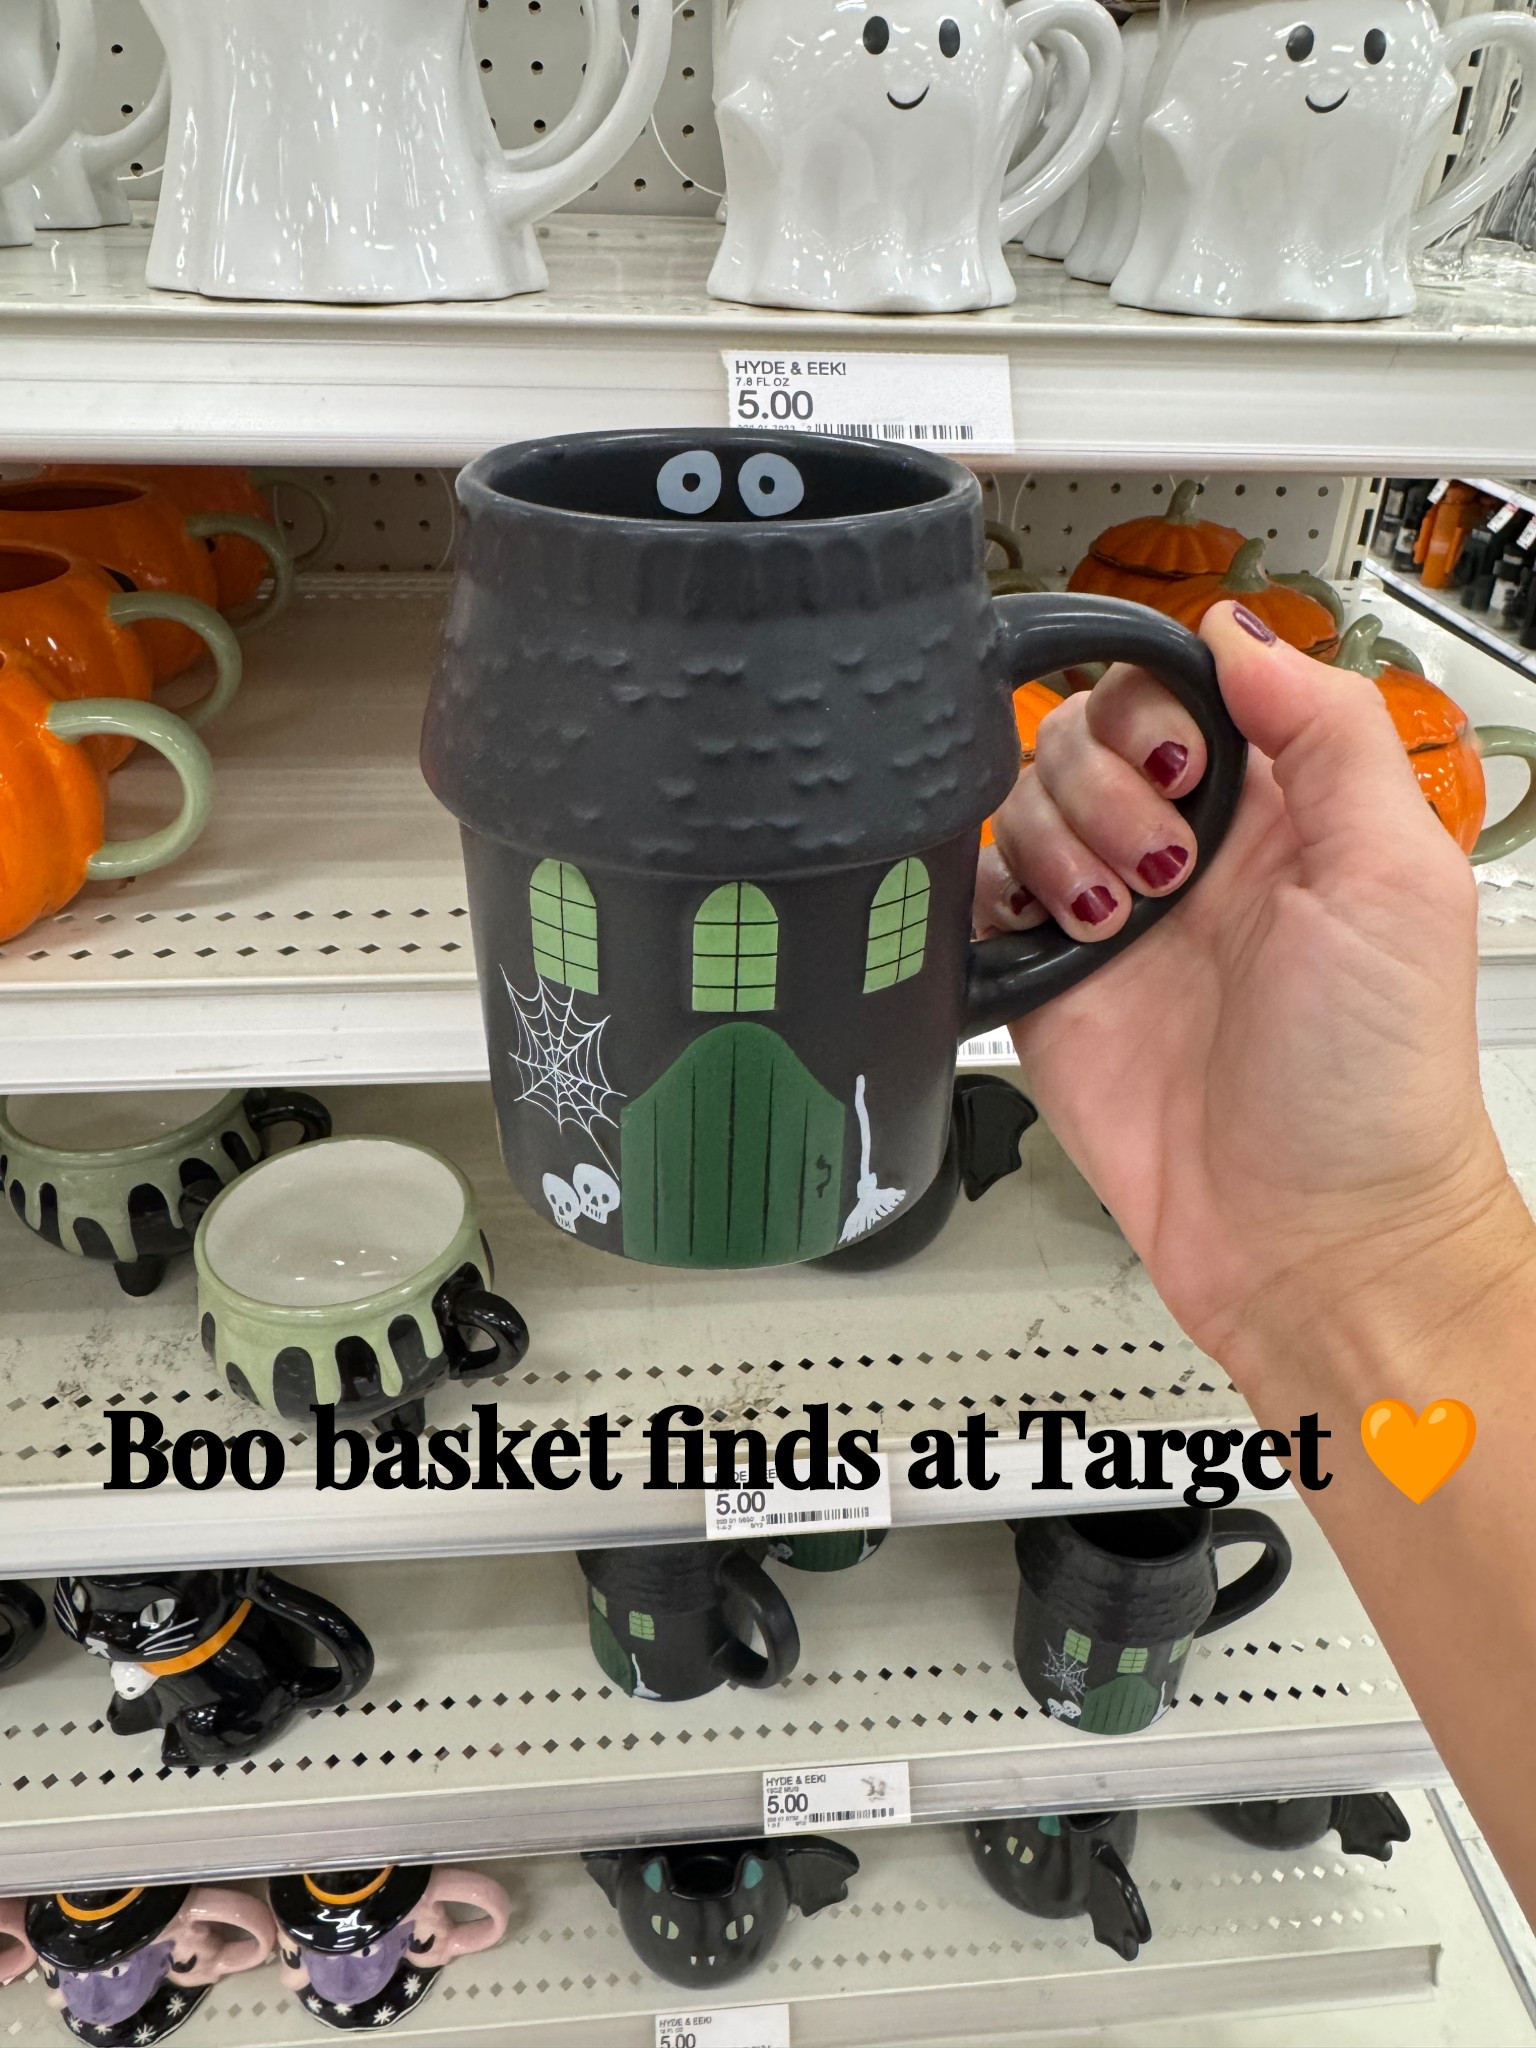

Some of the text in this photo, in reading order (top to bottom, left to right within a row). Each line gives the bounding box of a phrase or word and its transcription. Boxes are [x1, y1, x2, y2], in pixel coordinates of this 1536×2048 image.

[735, 360, 785, 375] HYDE
[791, 362, 803, 375] &
[735, 378, 790, 387] 7.8 FL OZ
[738, 389, 814, 420] 5.00
[716, 1490, 766, 1515] 5.00
[766, 1776, 793, 1787] HYDE
[796, 1775, 802, 1785] &
[767, 1793, 809, 1814] 5.00
[659, 2018, 683, 2028] HYDE
[685, 2017, 691, 2026] &
